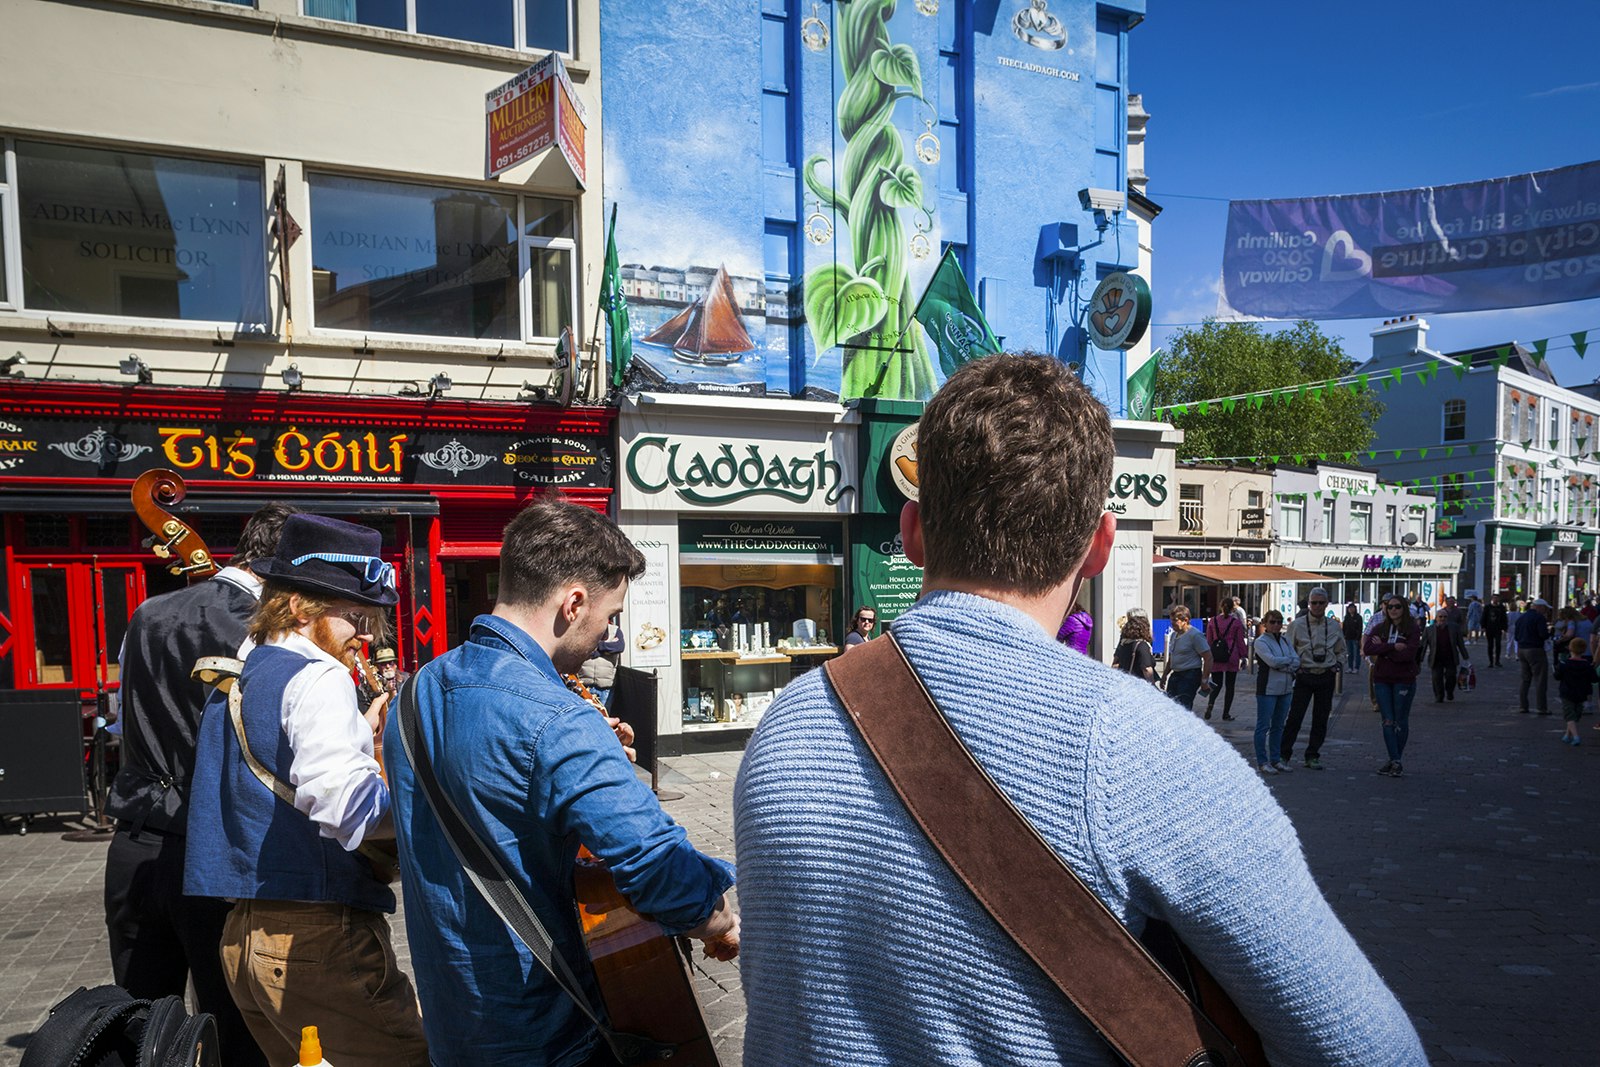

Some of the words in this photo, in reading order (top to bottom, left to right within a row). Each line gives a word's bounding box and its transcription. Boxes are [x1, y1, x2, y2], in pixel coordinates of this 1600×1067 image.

[487, 84, 508, 101] FIRST
[508, 70, 528, 90] FLOOR
[529, 53, 553, 75] OFFICE
[997, 56, 1079, 81] THECLADDAGH.COM
[493, 90, 514, 107] TO
[518, 69, 546, 93] LET
[492, 76, 552, 134] MULLERY
[499, 110, 546, 144] AUCTIONEERS
[33, 203, 133, 226] ADRIAN
[142, 212, 183, 231] Mac
[190, 217, 250, 236] LYNN
[79, 240, 210, 266] SOLICITOR
[323, 231, 409, 251] ADRIAN
[415, 239, 450, 256] Mac
[456, 242, 510, 261] LYNN
[362, 264, 473, 285] SOLICITOR
[698, 383, 751, 393] featurewalls.io
[319, 475, 375, 483] TRADITIONAL
[626, 436, 856, 507] Claddagh
[1326, 475, 1369, 492] CHEMIST
[729, 522, 750, 535] Visit
[752, 526, 763, 534] our
[763, 523, 796, 535] Website
[1170, 550, 1187, 558] Cafe
[1188, 551, 1217, 559] Express
